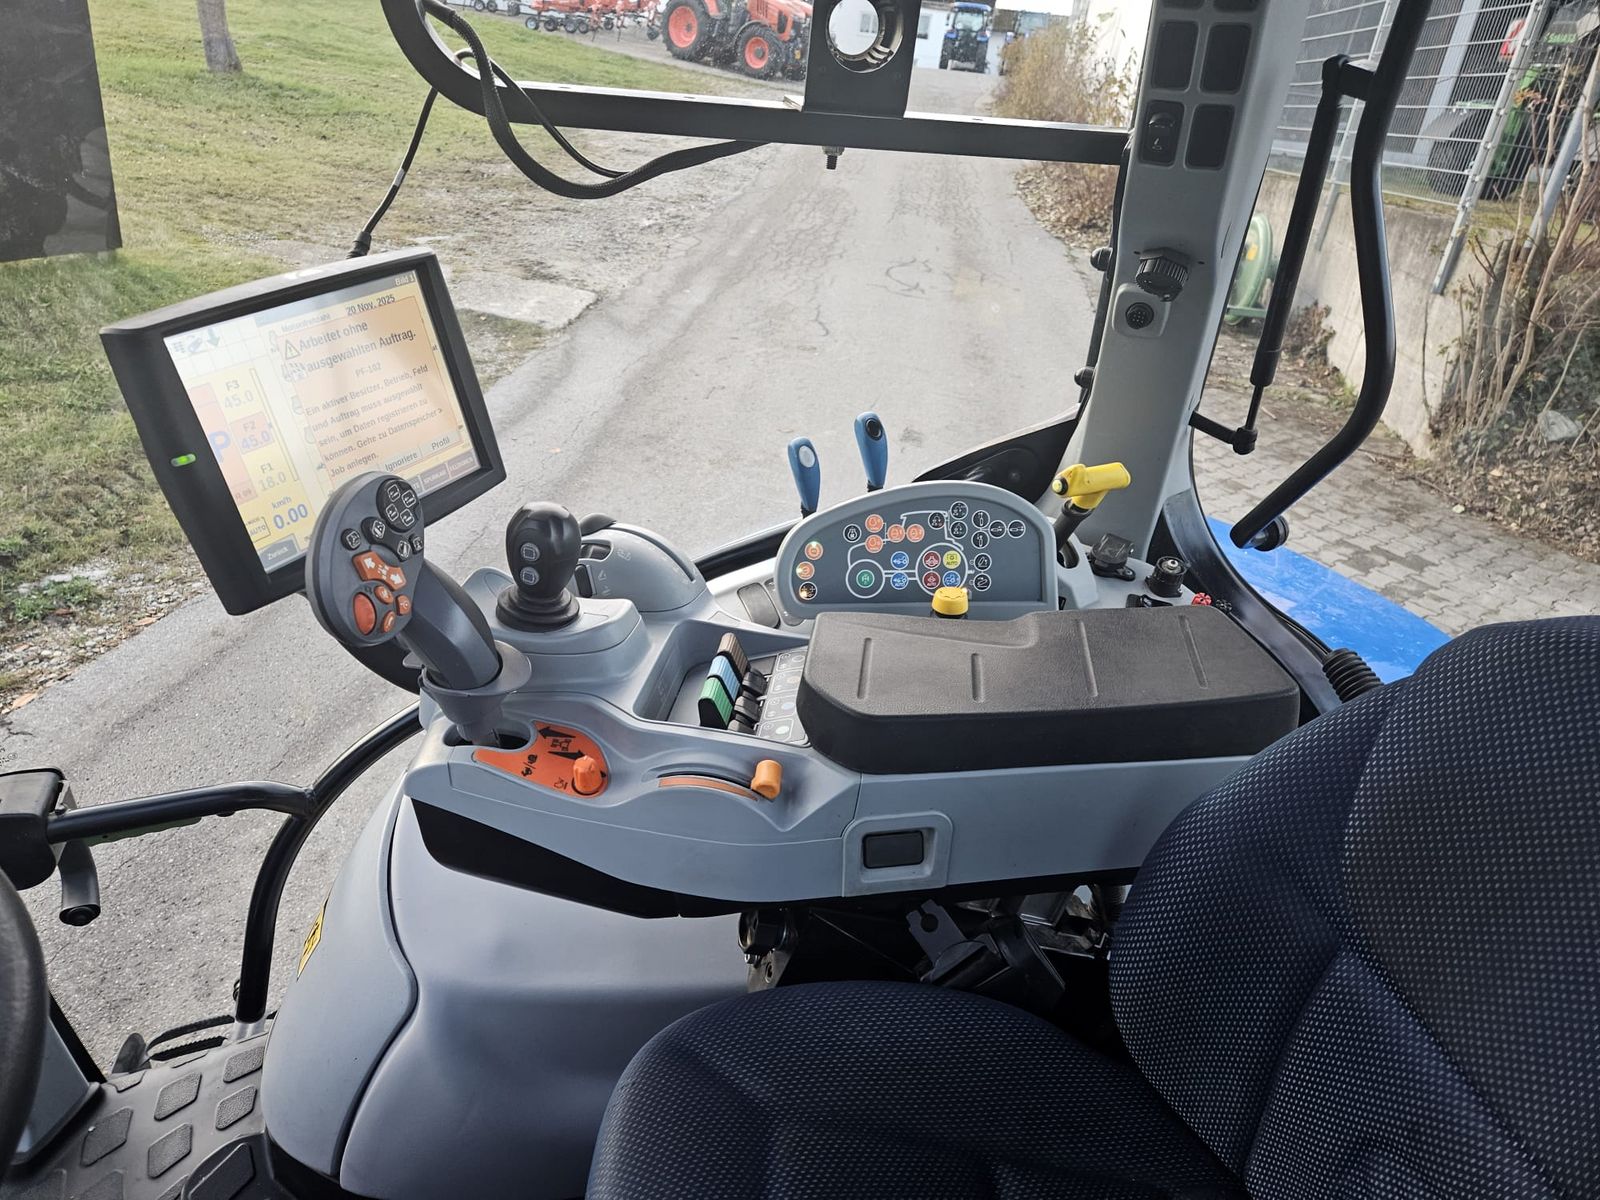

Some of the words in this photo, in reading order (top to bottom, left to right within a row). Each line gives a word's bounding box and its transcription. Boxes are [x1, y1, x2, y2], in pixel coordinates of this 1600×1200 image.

[345, 305, 357, 316] 20
[357, 299, 377, 312] Nov.
[377, 294, 396, 307] 2025
[298, 330, 341, 351] Arbeitet
[343, 320, 368, 337] ohne
[378, 328, 416, 349] Auftrag.
[225, 378, 241, 391] F3
[306, 405, 320, 417] Ein
[322, 394, 349, 410] aktiver
[412, 363, 429, 377] Feld
[223, 390, 254, 409] 45.0
[242, 420, 257, 432] F2
[312, 419, 329, 432] und
[330, 407, 360, 425] Auftrag
[340, 427, 353, 439] um
[353, 418, 376, 433] Daten
[208, 431, 232, 464] P
[240, 430, 271, 450] 45.0
[356, 434, 377, 449] Gehe
[385, 451, 418, 472] Ignoriere
[431, 436, 450, 451] Profil
[259, 462, 274, 474] F1
[331, 465, 345, 478] Job
[258, 471, 287, 492] 18.0
[272, 503, 310, 530] 0.00
